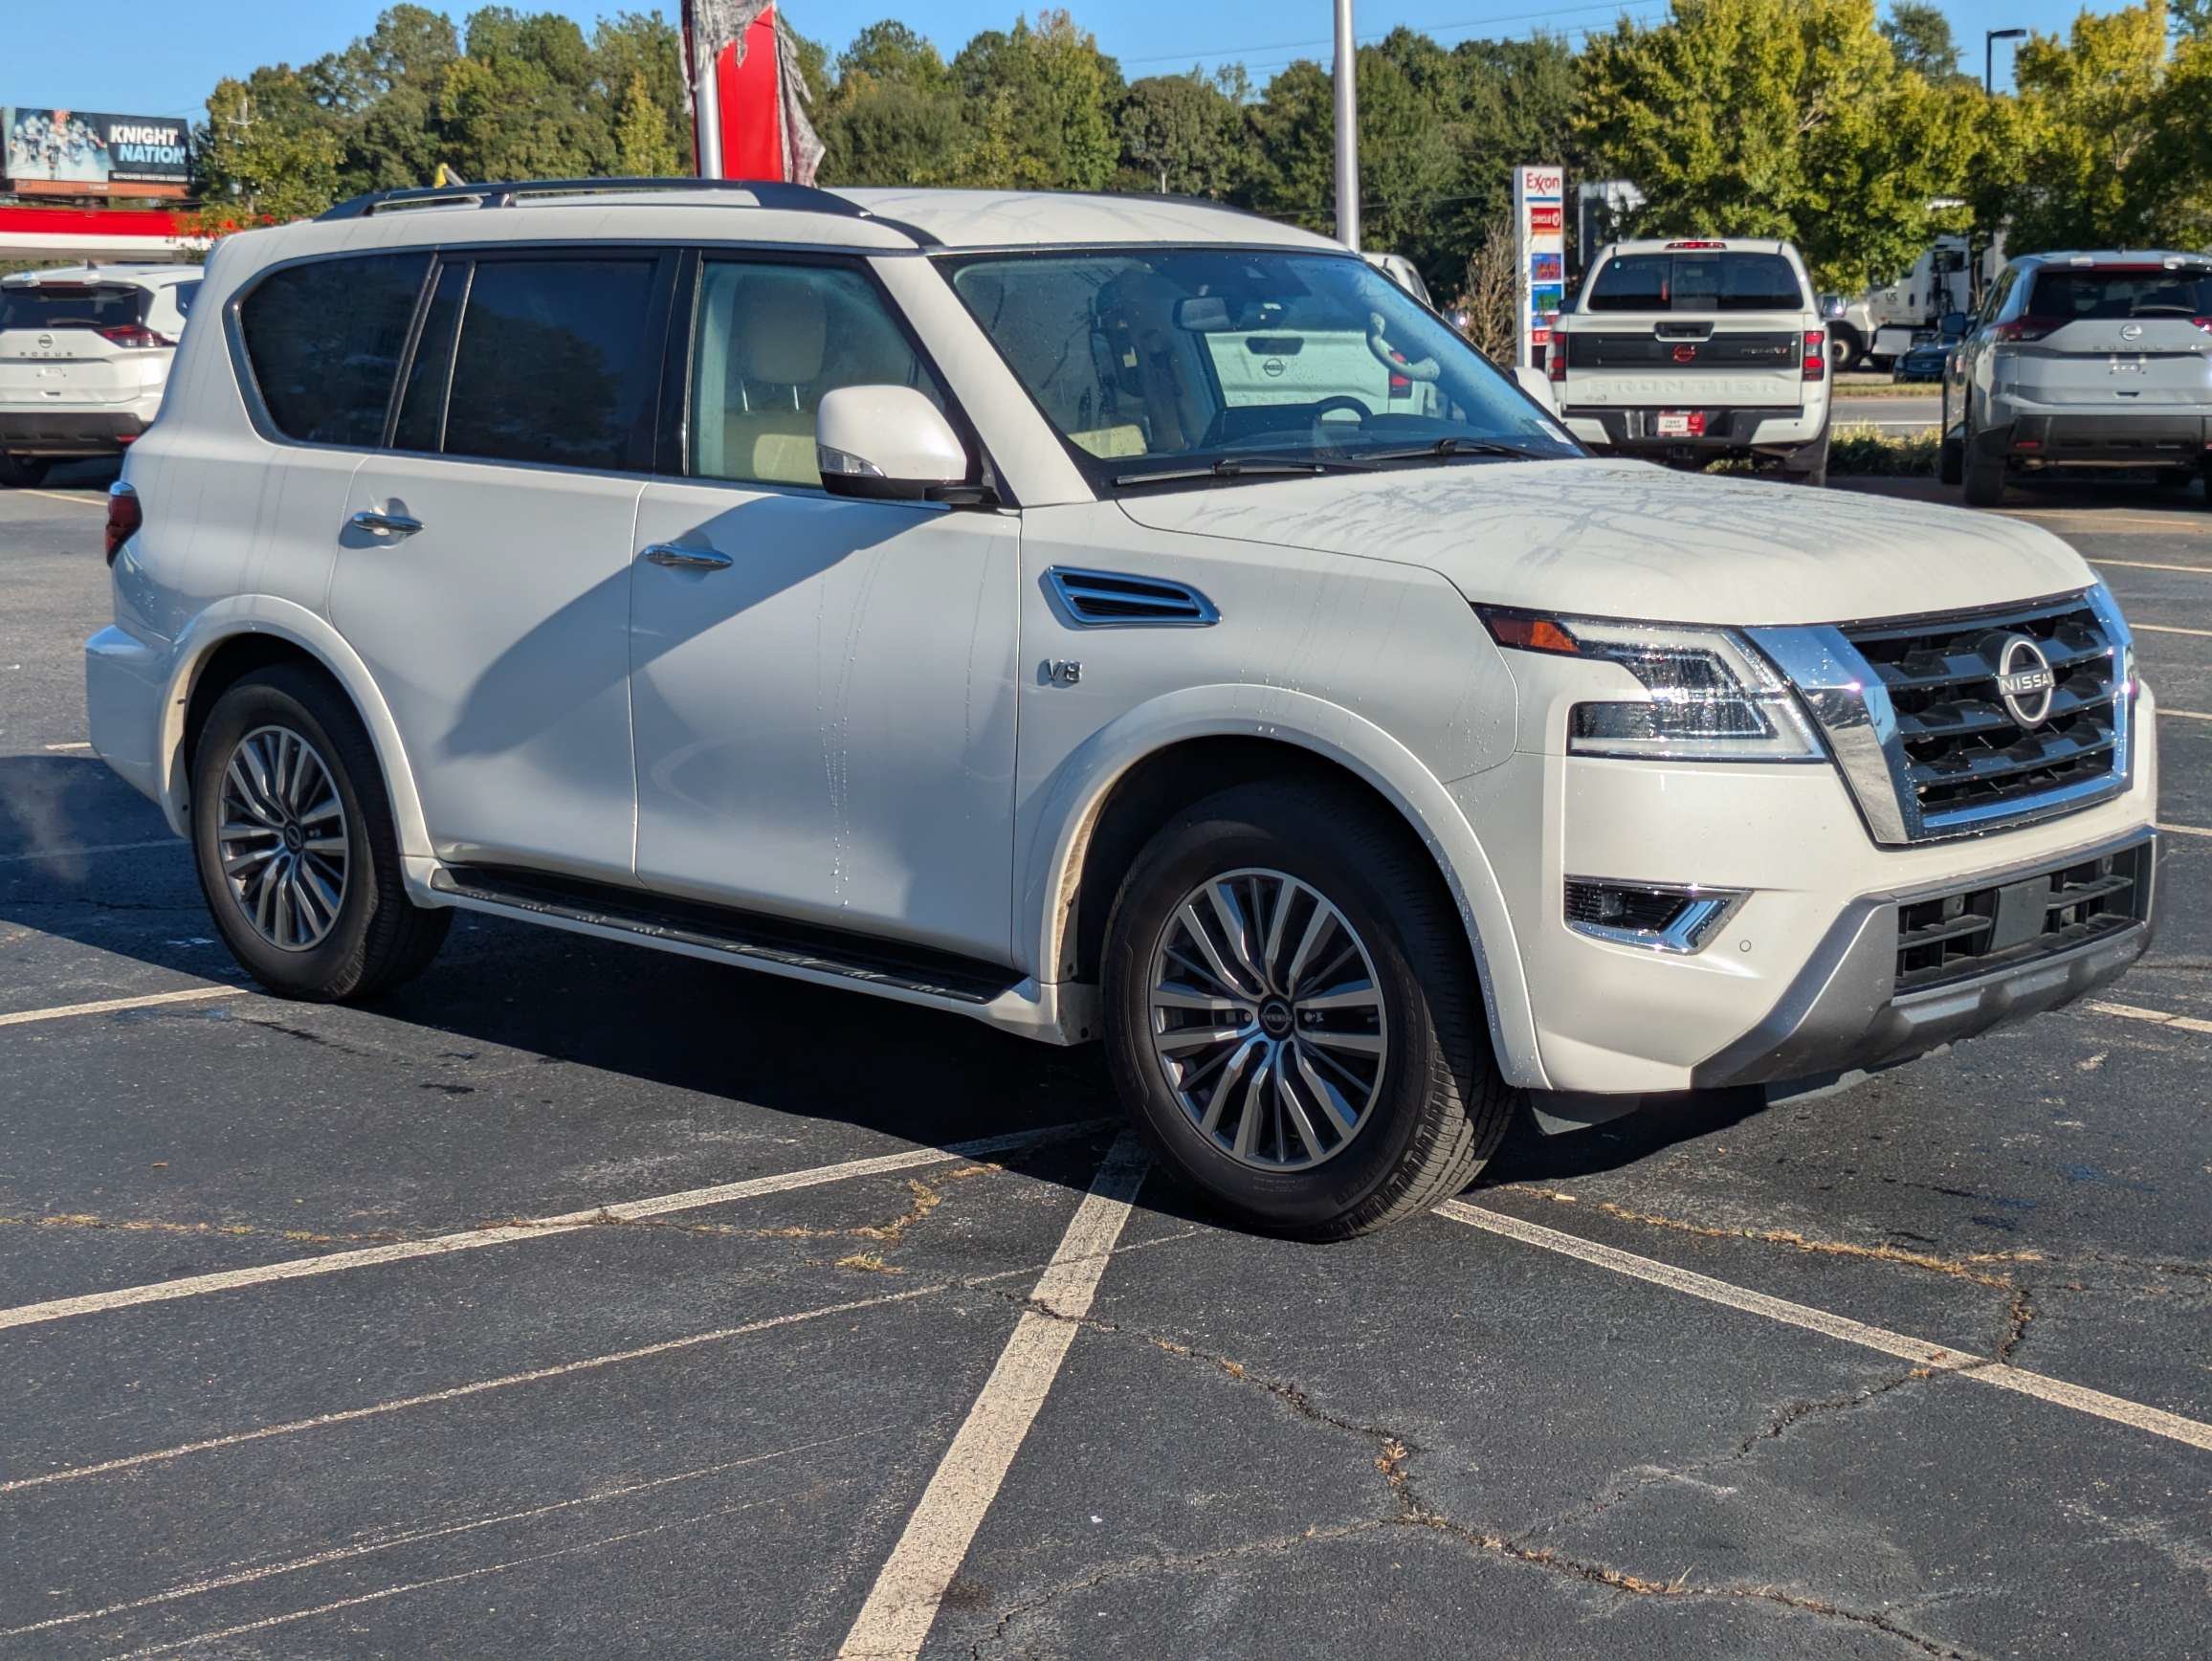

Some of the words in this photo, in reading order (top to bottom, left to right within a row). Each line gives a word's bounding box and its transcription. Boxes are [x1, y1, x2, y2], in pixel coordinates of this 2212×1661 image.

[110, 124, 179, 146] KNIGHT
[119, 144, 186, 165] NATION
[1526, 172, 1559, 196] Exxon
[1585, 380, 1780, 395] FRONTIER
[1047, 658, 1083, 684] V8
